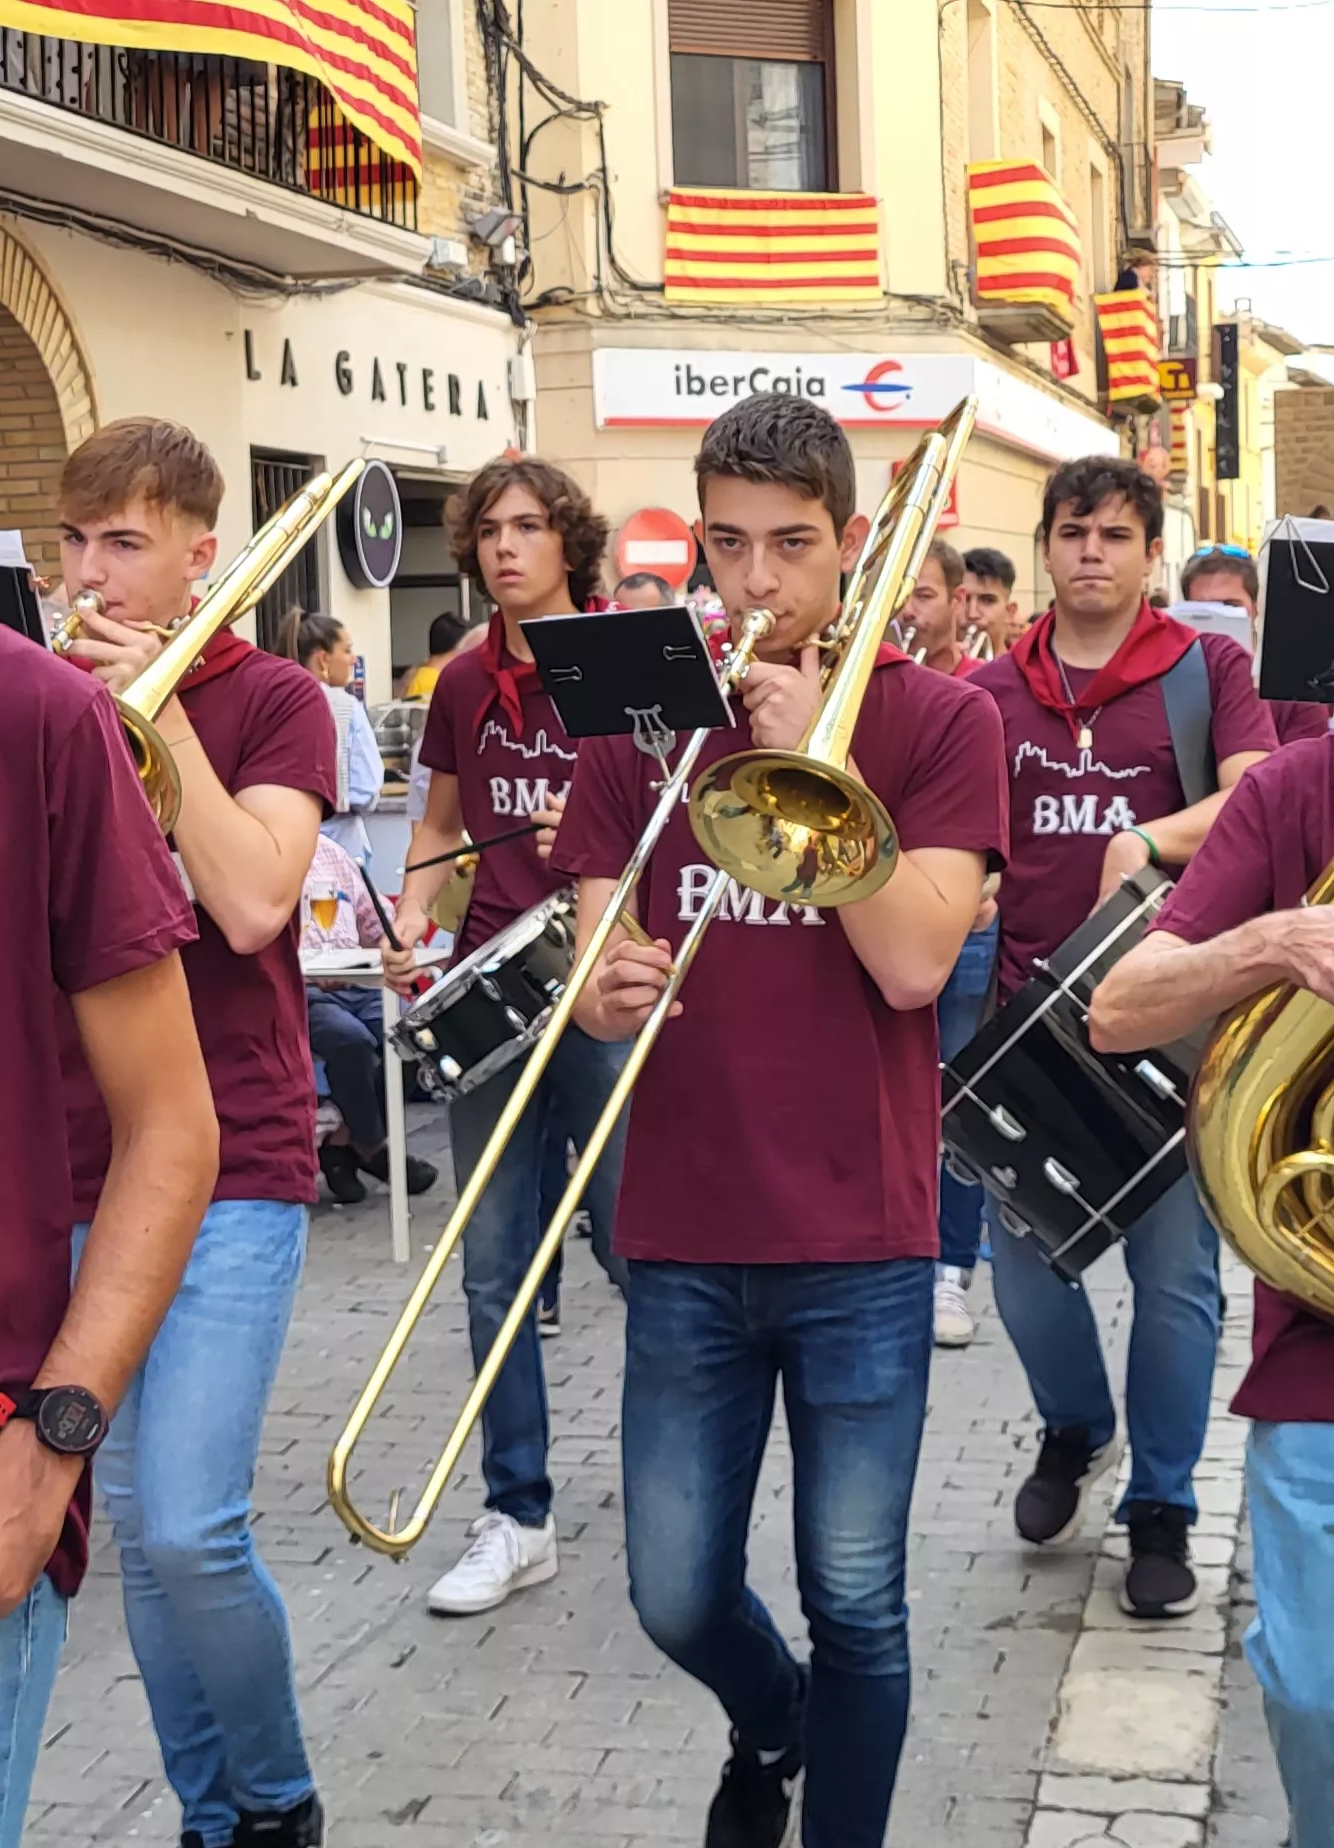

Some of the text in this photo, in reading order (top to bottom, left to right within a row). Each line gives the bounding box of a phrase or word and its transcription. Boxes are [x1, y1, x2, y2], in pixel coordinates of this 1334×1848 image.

[244, 329, 489, 421] LA GATERA
[1033, 794, 1137, 835] BMA
